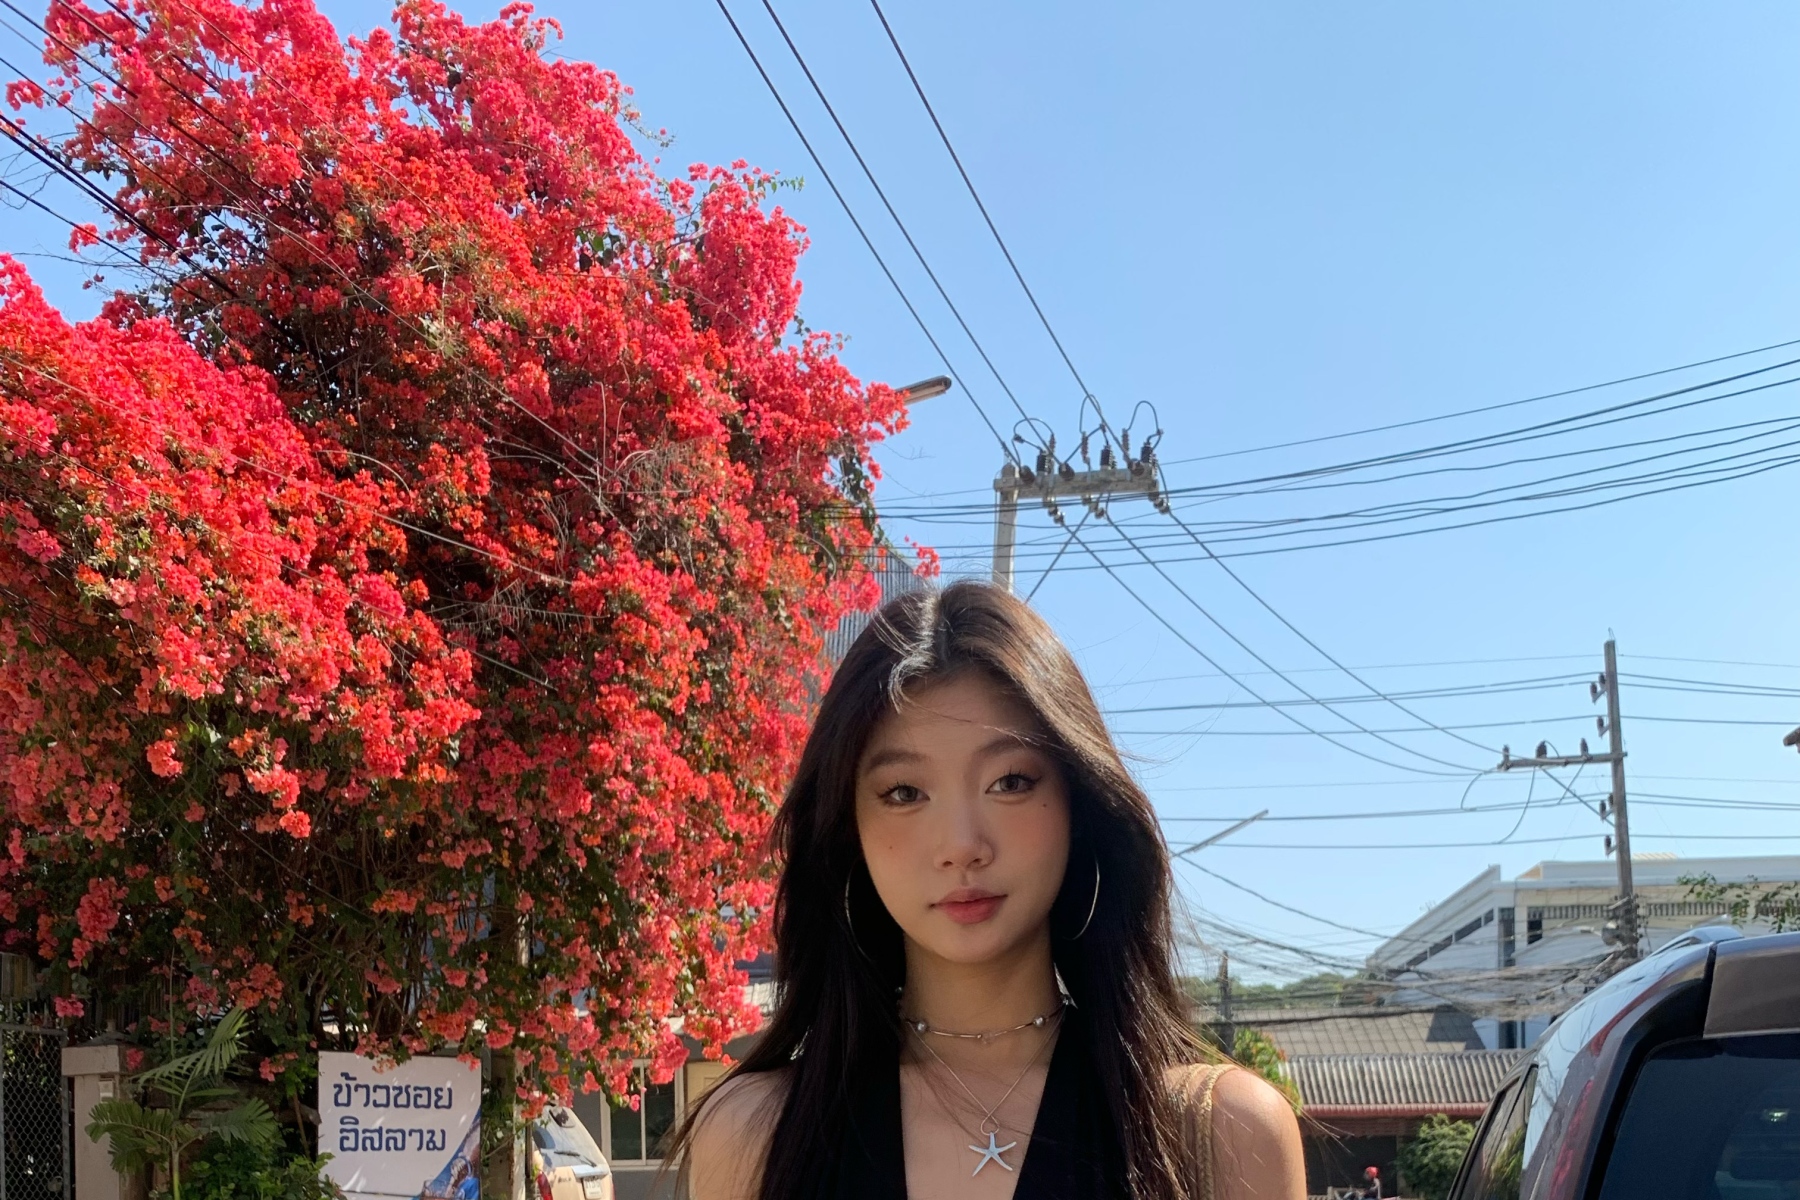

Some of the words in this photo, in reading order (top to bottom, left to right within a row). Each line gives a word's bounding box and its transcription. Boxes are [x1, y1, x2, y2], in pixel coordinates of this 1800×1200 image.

[333, 1072, 453, 1109] ข้าวซอย
[339, 1115, 446, 1152] อิสลาม
